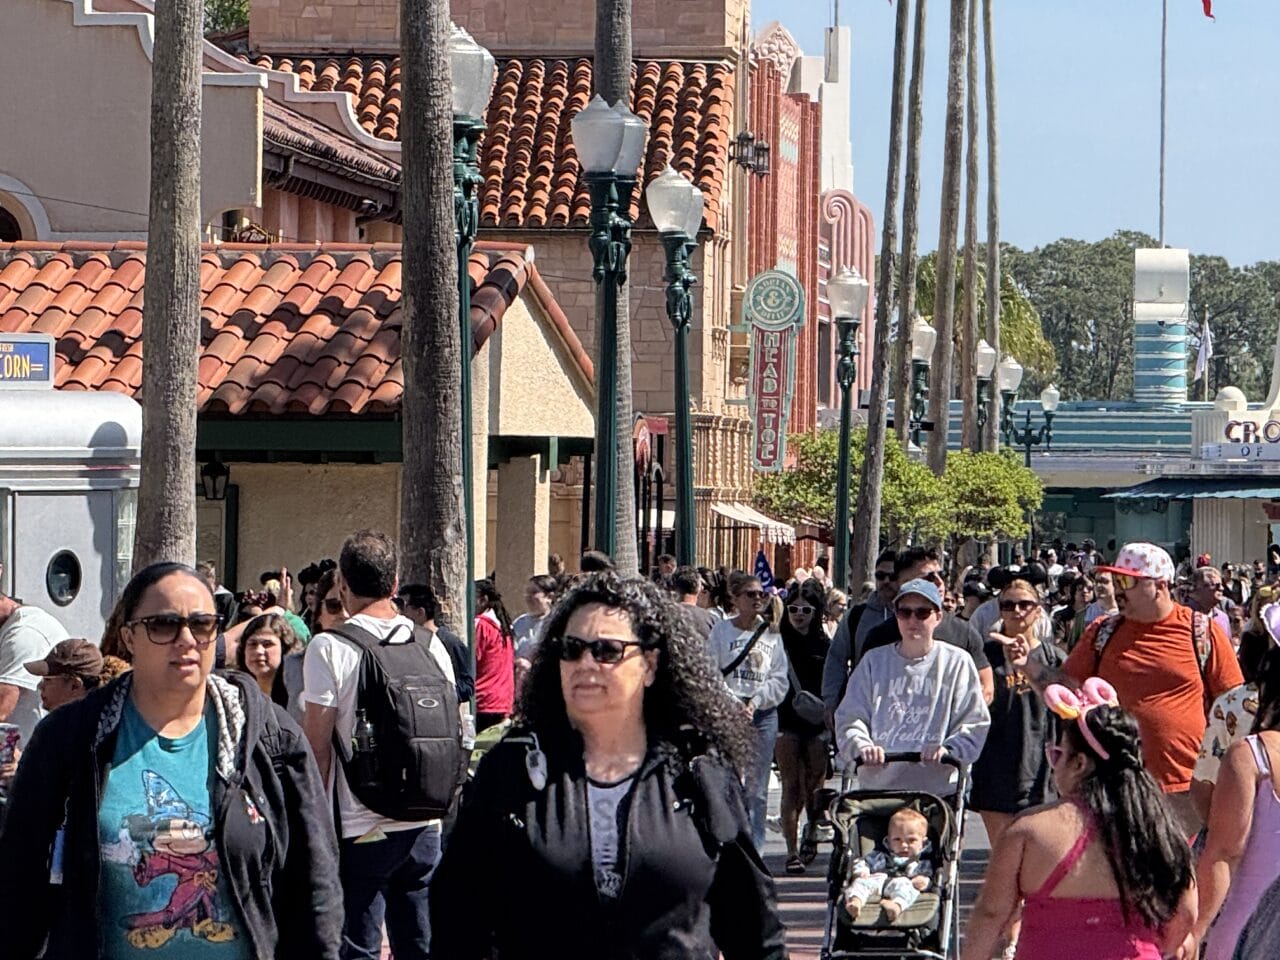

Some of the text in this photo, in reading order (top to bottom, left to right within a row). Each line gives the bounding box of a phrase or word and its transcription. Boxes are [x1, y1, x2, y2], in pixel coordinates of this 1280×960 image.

[762, 331, 780, 394] HEAD
[760, 398, 778, 409] TO
[761, 412, 777, 460] TOE
[1240, 445, 1263, 458] OF
